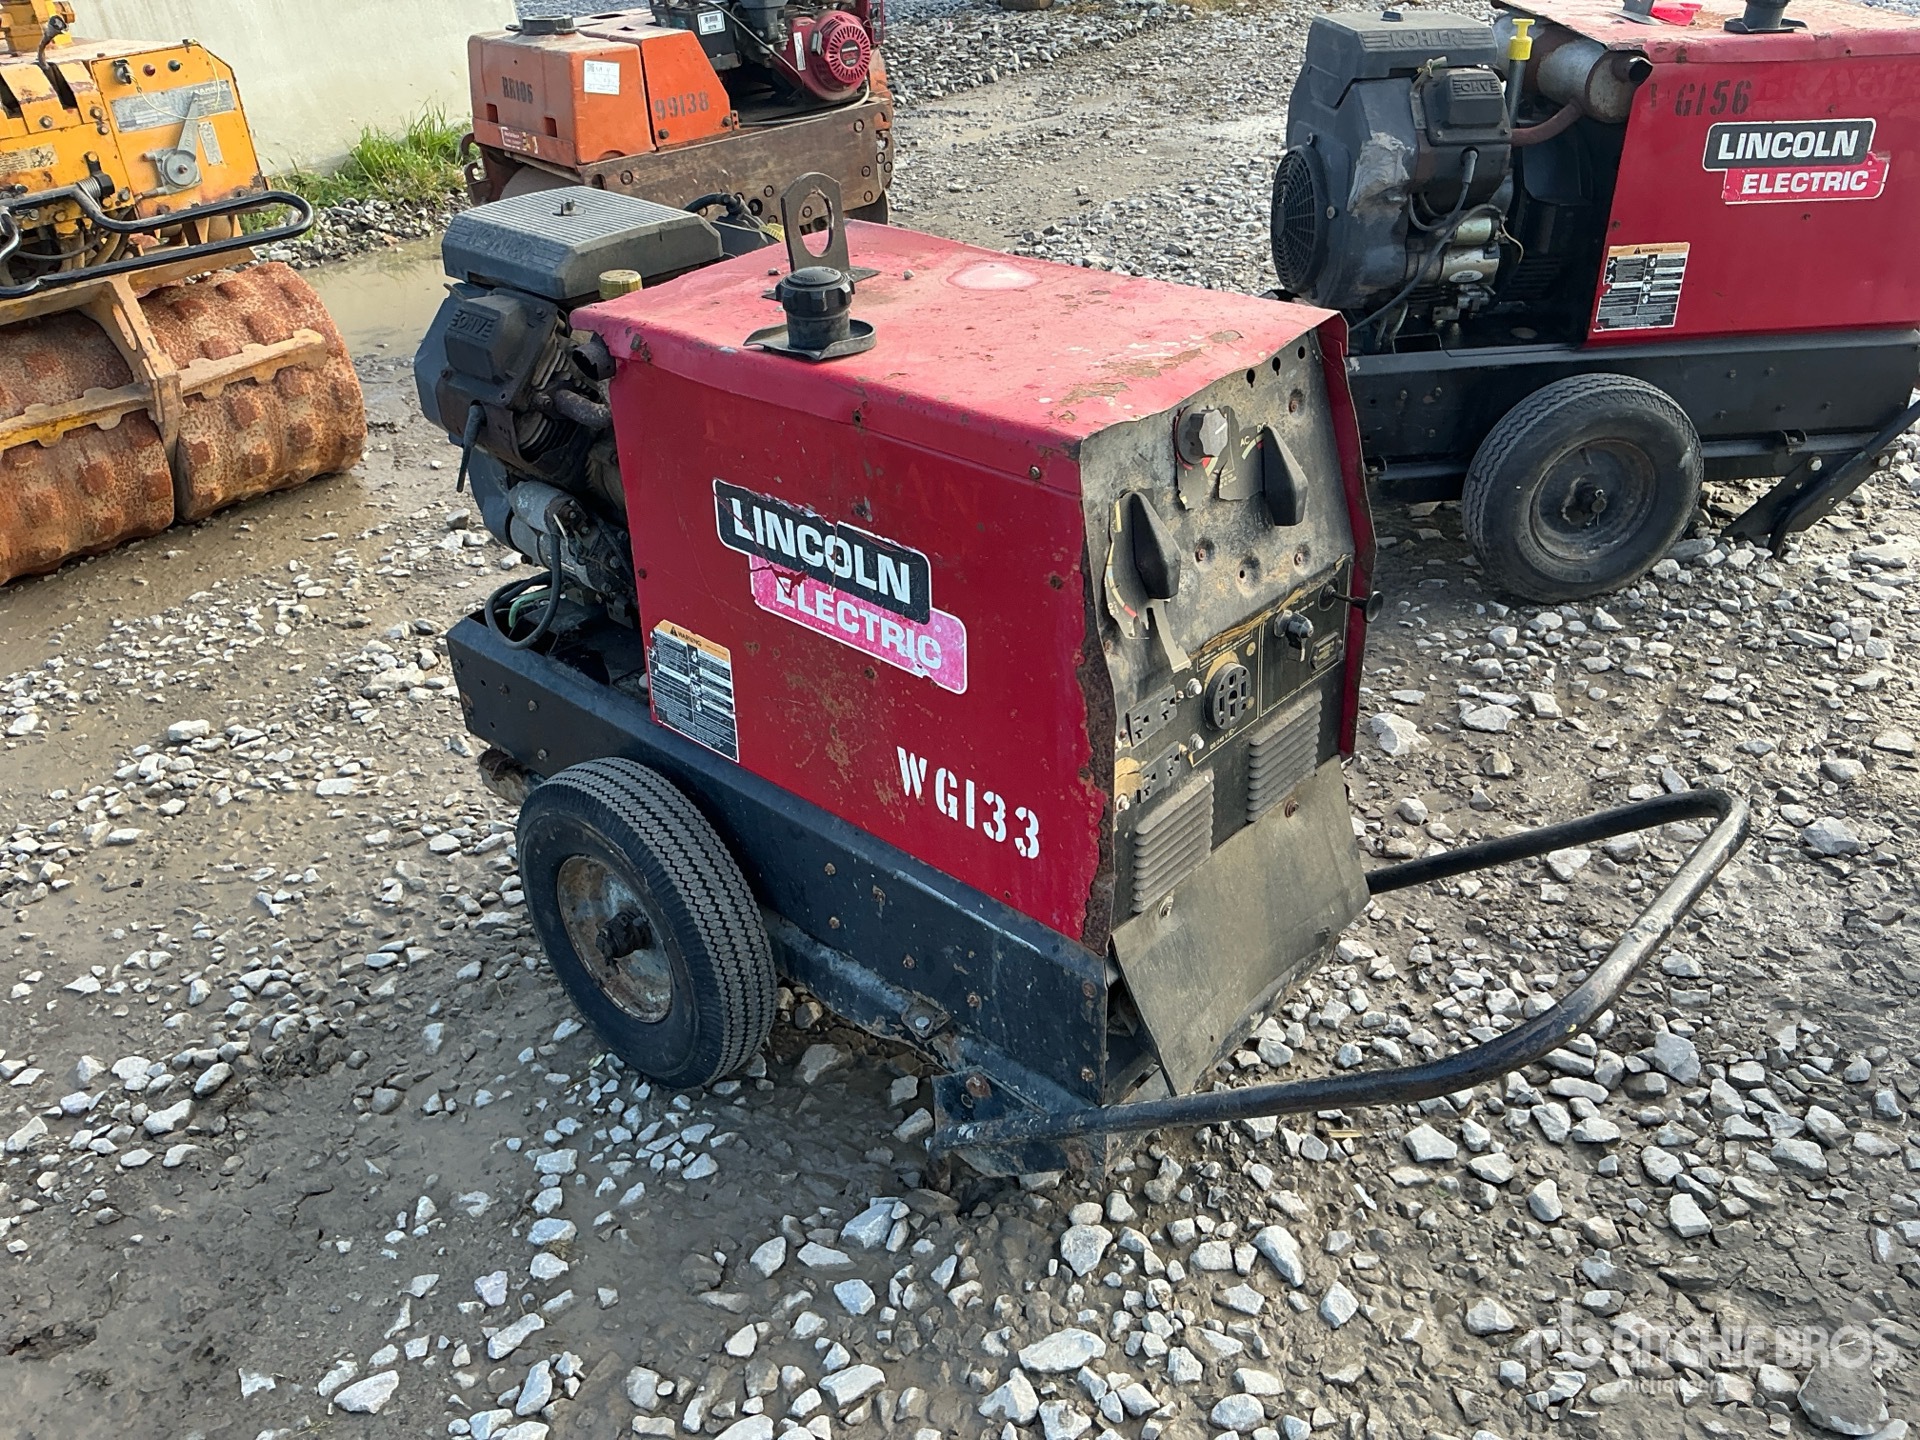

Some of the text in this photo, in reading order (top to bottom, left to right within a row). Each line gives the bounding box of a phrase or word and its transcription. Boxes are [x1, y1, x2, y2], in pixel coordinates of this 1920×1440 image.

[1390, 30, 1462, 48] KOHLER
[654, 92, 710, 120] 99138
[1717, 130, 1859, 160] LINCOLN
[1741, 171, 1869, 195] ELECTRIC
[1240, 435, 1250, 447] AC
[731, 497, 911, 605] LINCOLN
[776, 577, 942, 670] ELECTRIC
[678, 630, 702, 647] WARNING
[897, 746, 1040, 859] WG133
